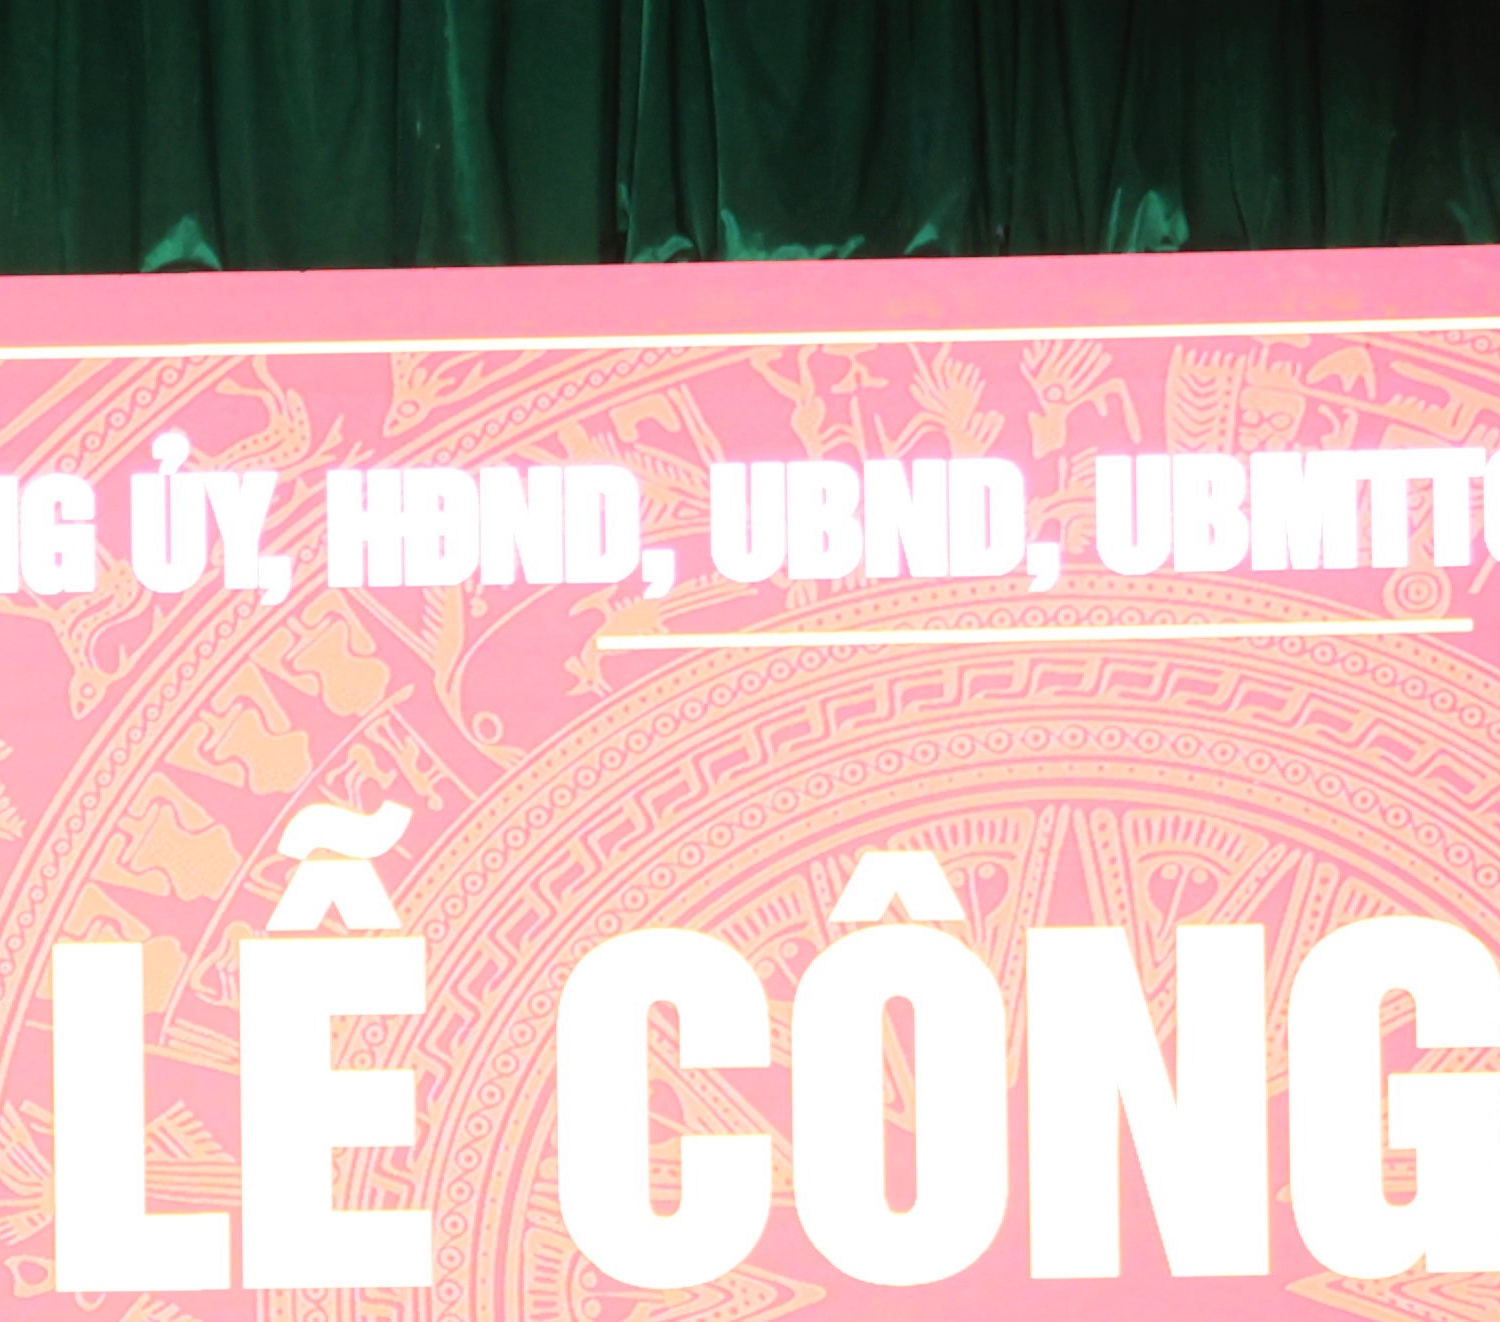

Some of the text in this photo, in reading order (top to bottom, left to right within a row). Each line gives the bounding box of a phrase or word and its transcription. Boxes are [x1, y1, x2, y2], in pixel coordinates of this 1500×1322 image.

[130, 433, 292, 605] ỦY,
[325, 464, 675, 599] HĐND,
[709, 458, 1060, 592] UBND,
[53, 802, 434, 1292] LỄ
